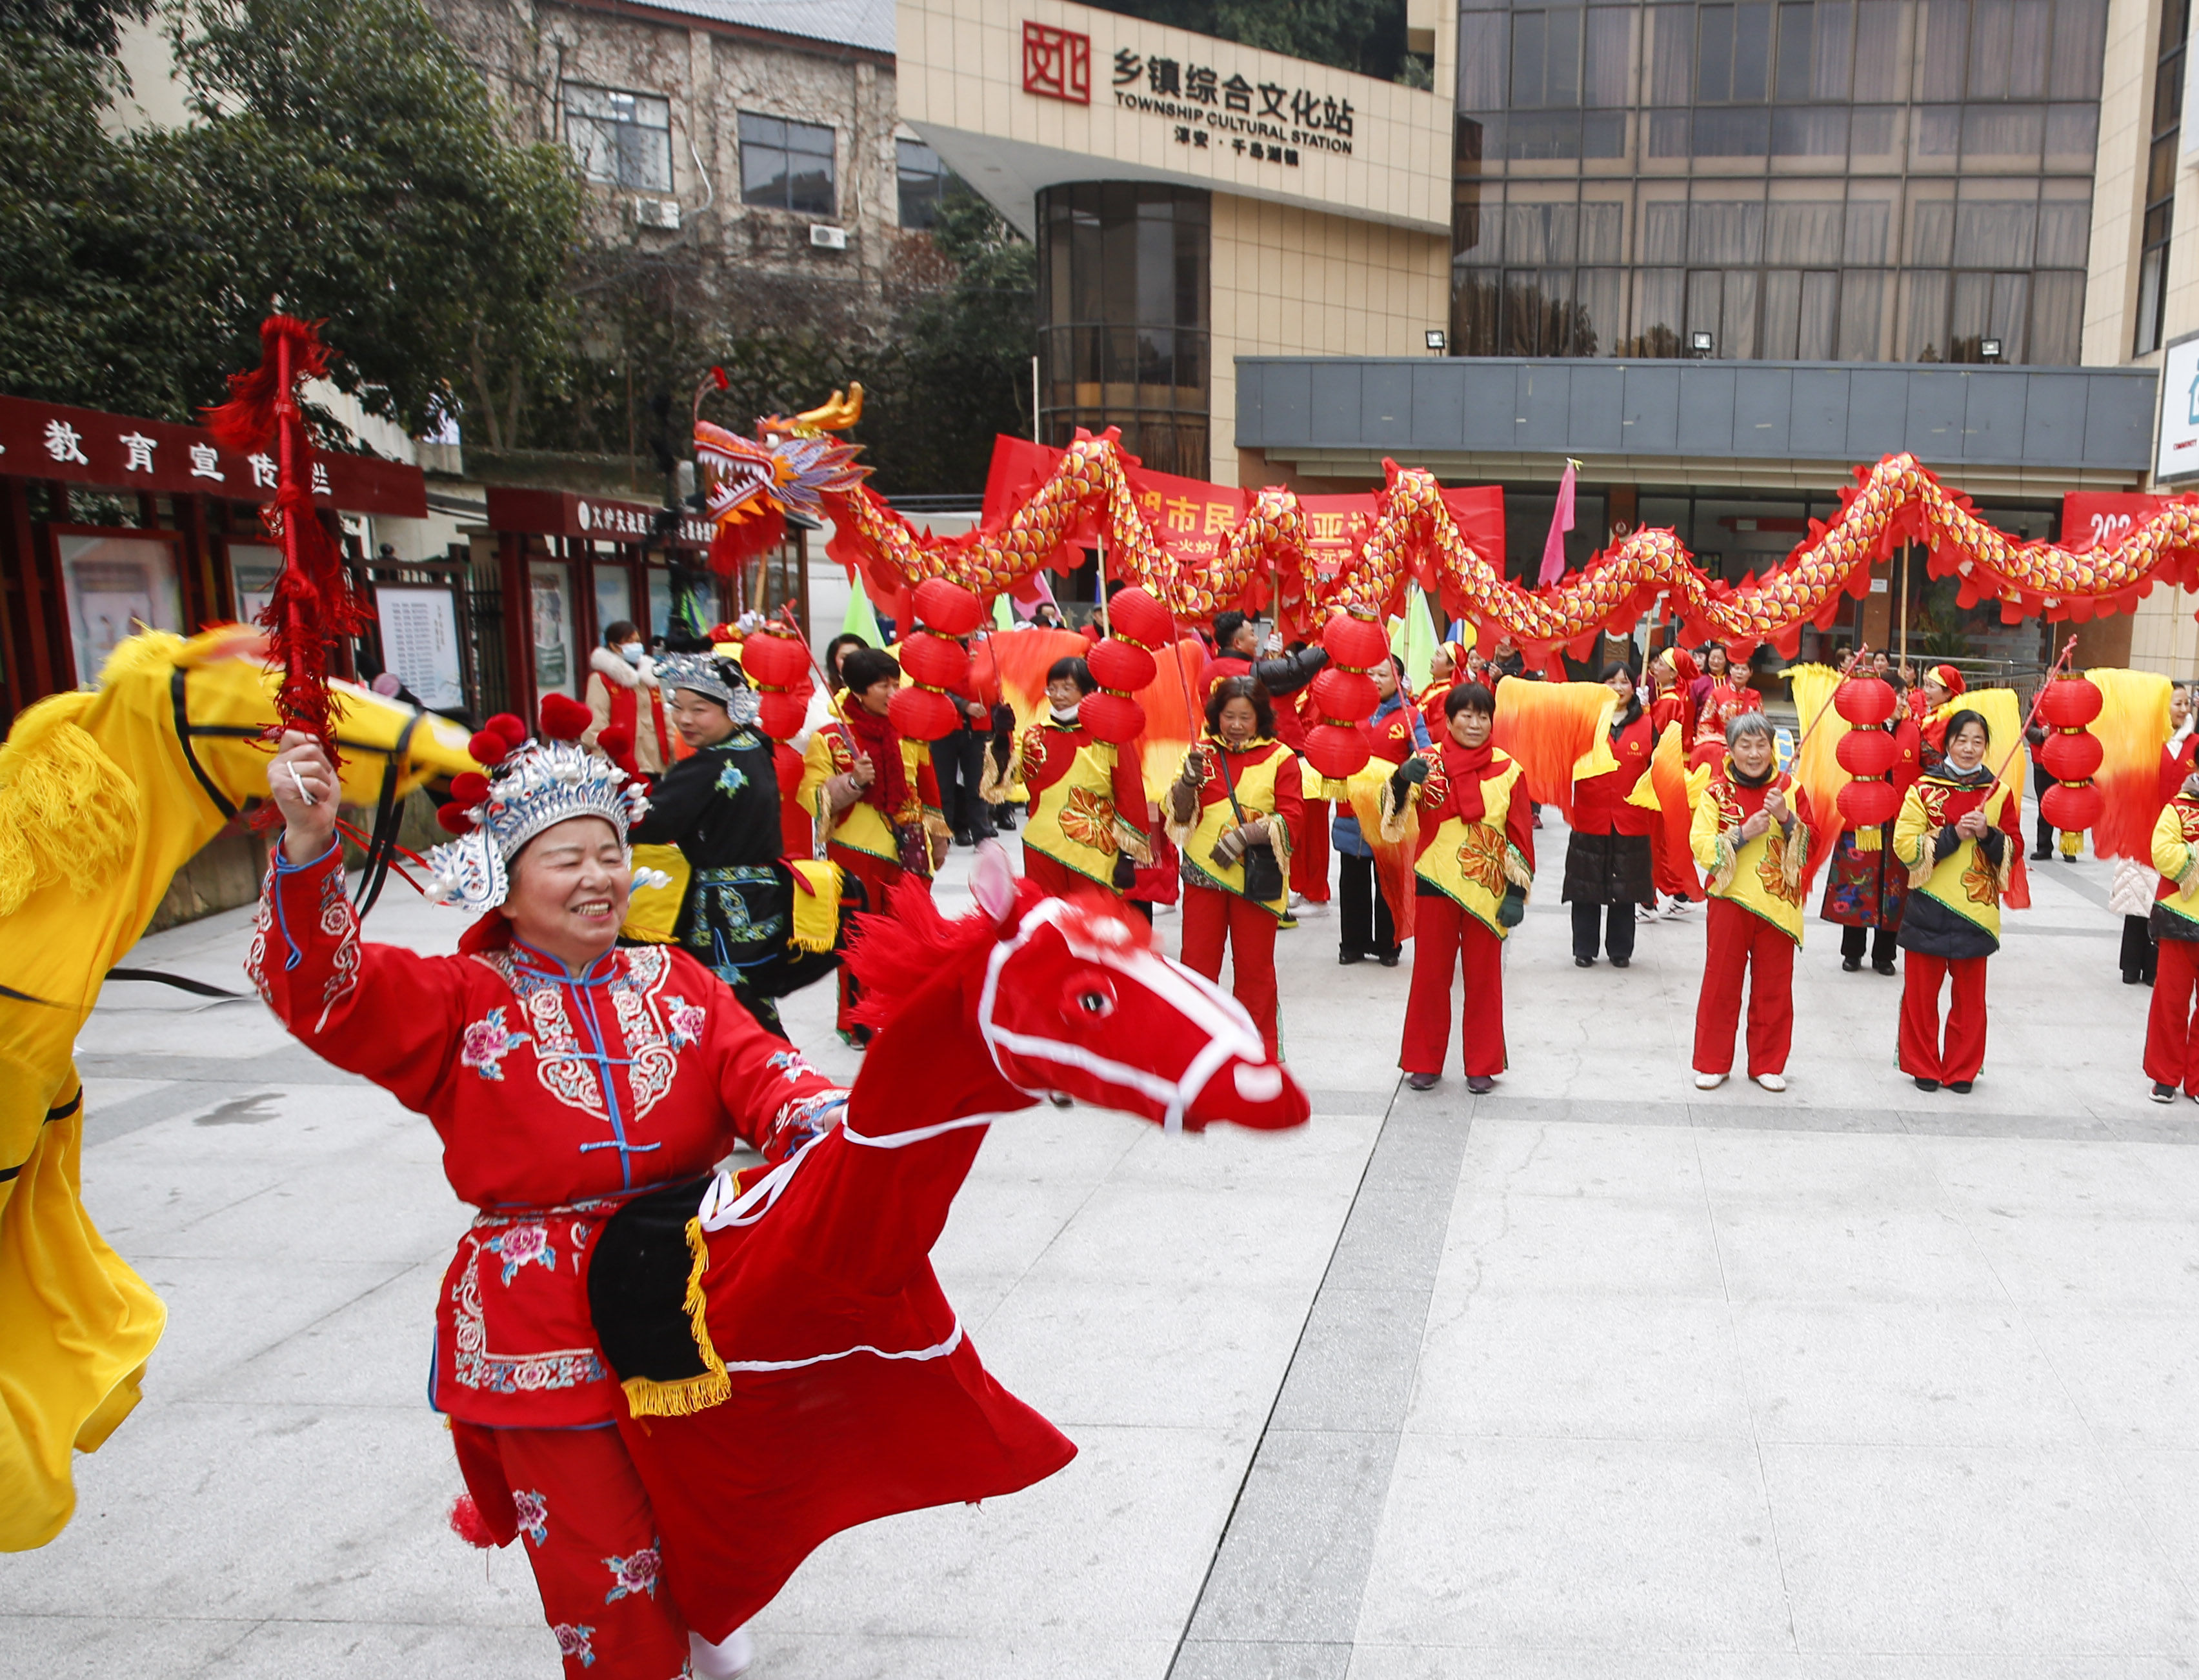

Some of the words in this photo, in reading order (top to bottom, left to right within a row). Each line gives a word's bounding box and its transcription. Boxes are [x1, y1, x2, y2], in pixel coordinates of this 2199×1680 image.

[1113, 47, 1354, 137] 乡镇综合文化站
[1115, 90, 1203, 121] TOWNSHIP
[1207, 111, 1287, 141] CULTURAL
[1292, 130, 1352, 155] STATION
